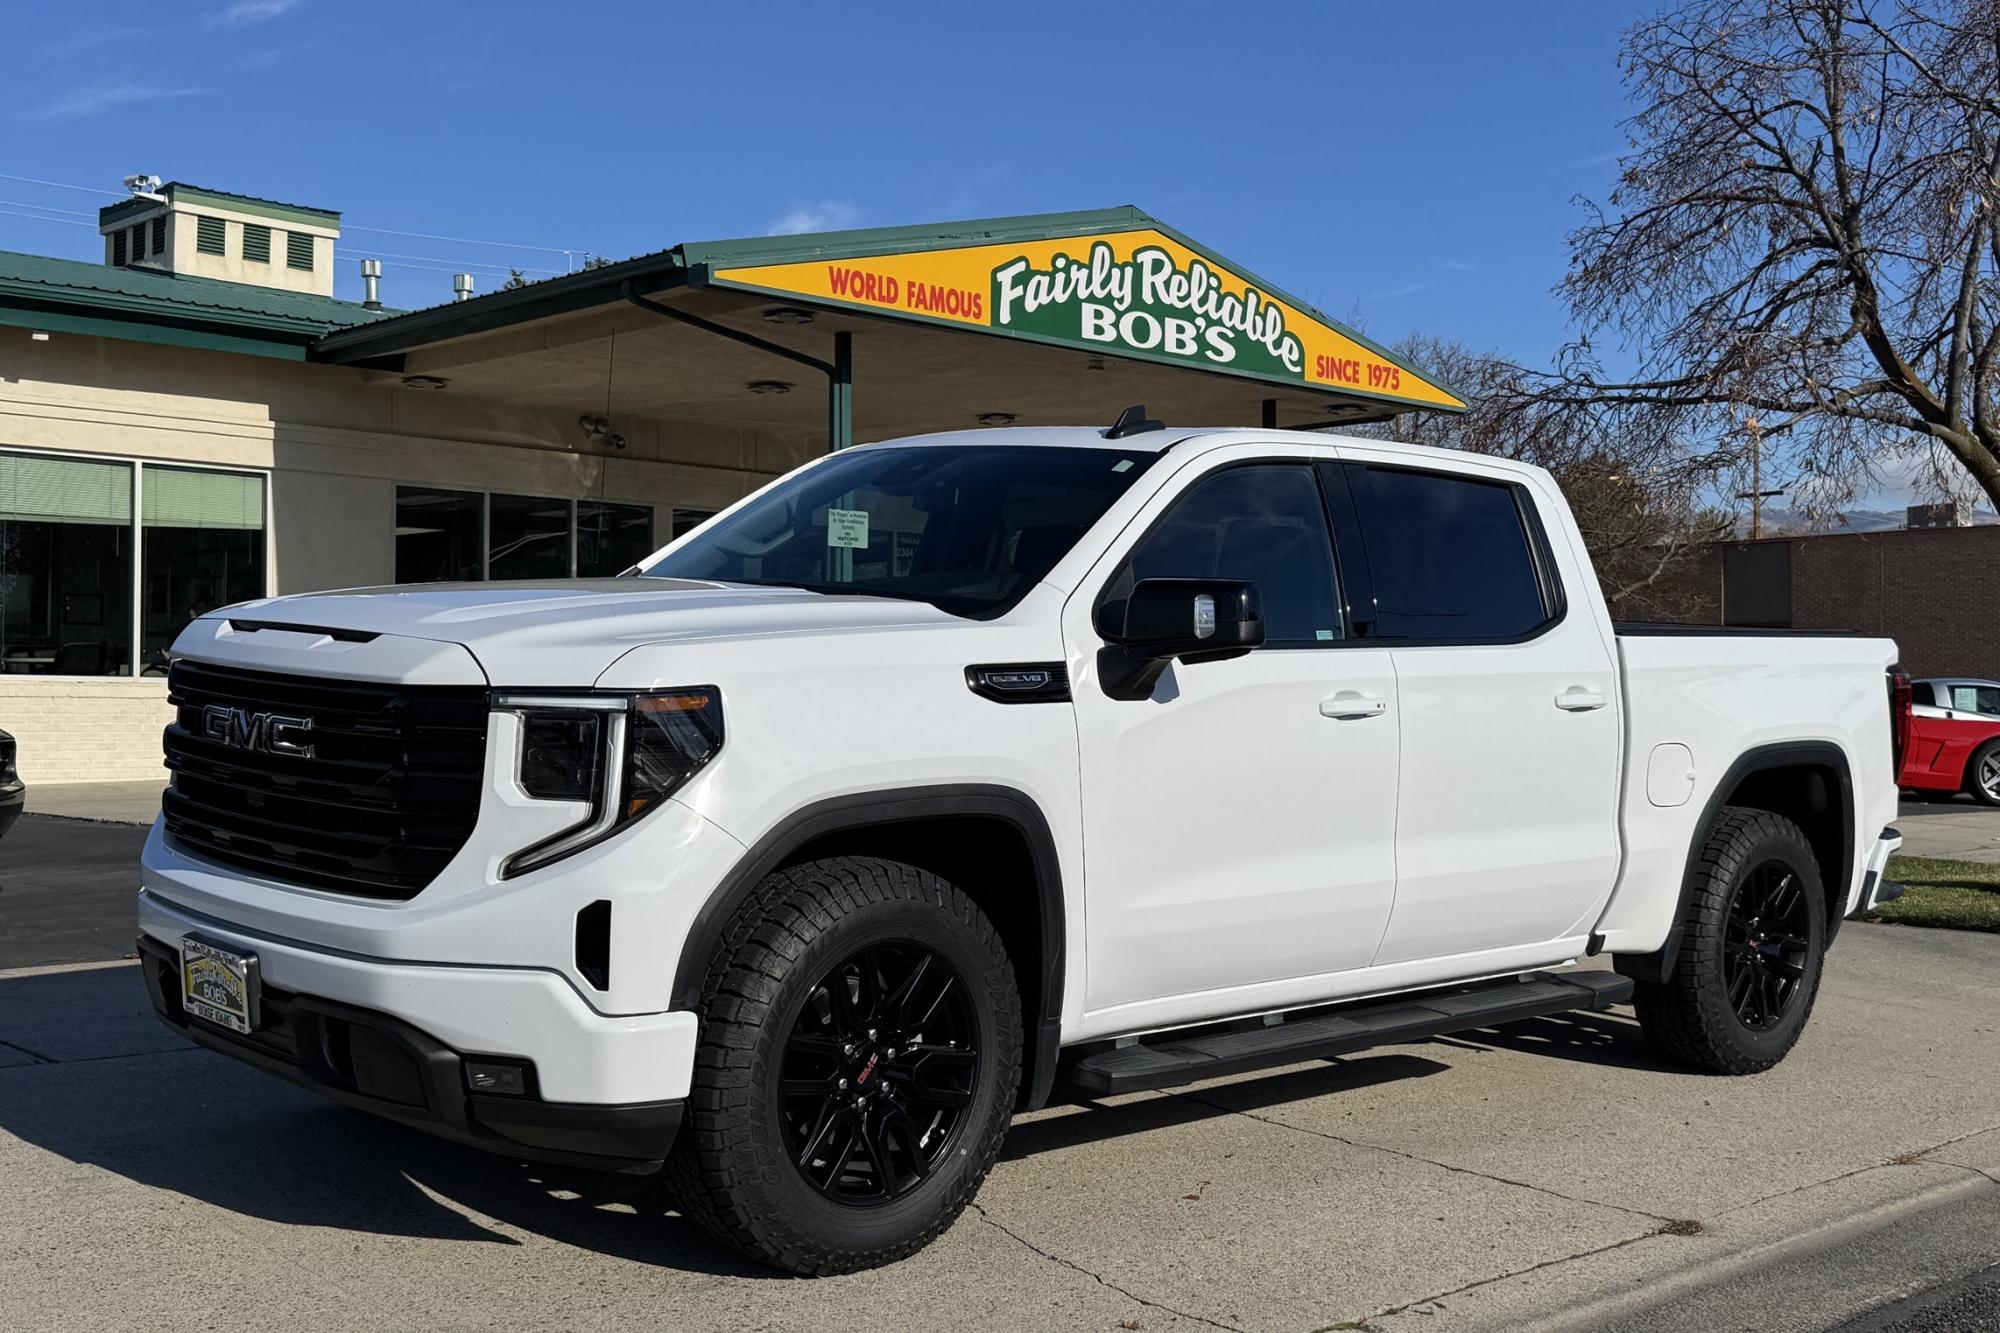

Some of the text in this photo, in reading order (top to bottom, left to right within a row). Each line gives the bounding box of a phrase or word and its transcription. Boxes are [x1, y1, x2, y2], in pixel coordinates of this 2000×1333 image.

[828, 265, 982, 320] WORLD FAMOUS
[996, 245, 1302, 373] Fairly Reliable
[1081, 302, 1236, 362] BOB'S
[1316, 354, 1400, 390] SINCE 1975
[203, 704, 316, 759] GMC
